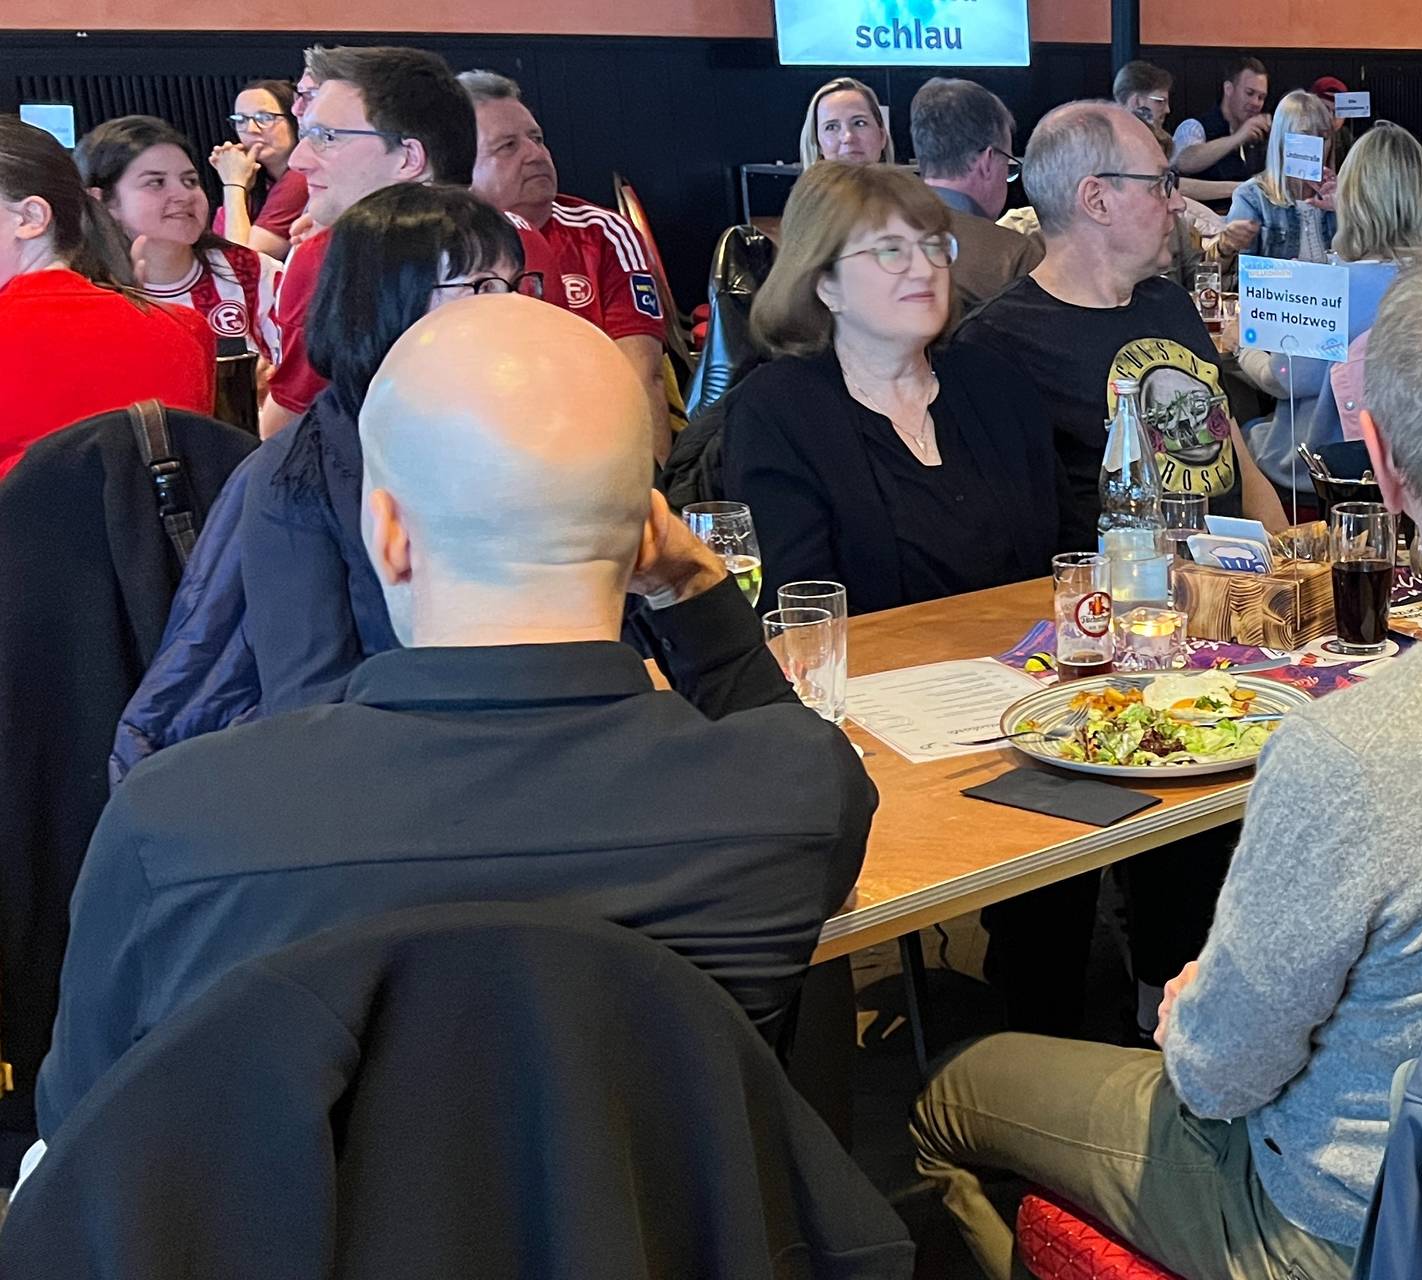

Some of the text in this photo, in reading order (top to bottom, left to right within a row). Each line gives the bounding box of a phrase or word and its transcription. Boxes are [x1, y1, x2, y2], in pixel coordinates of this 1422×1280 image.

[856, 18, 962, 49] schlau
[1246, 286, 1342, 309] Halbwissen auf
[1250, 307, 1336, 332] dem Holzweg
[1115, 342, 1169, 379] GUNS
